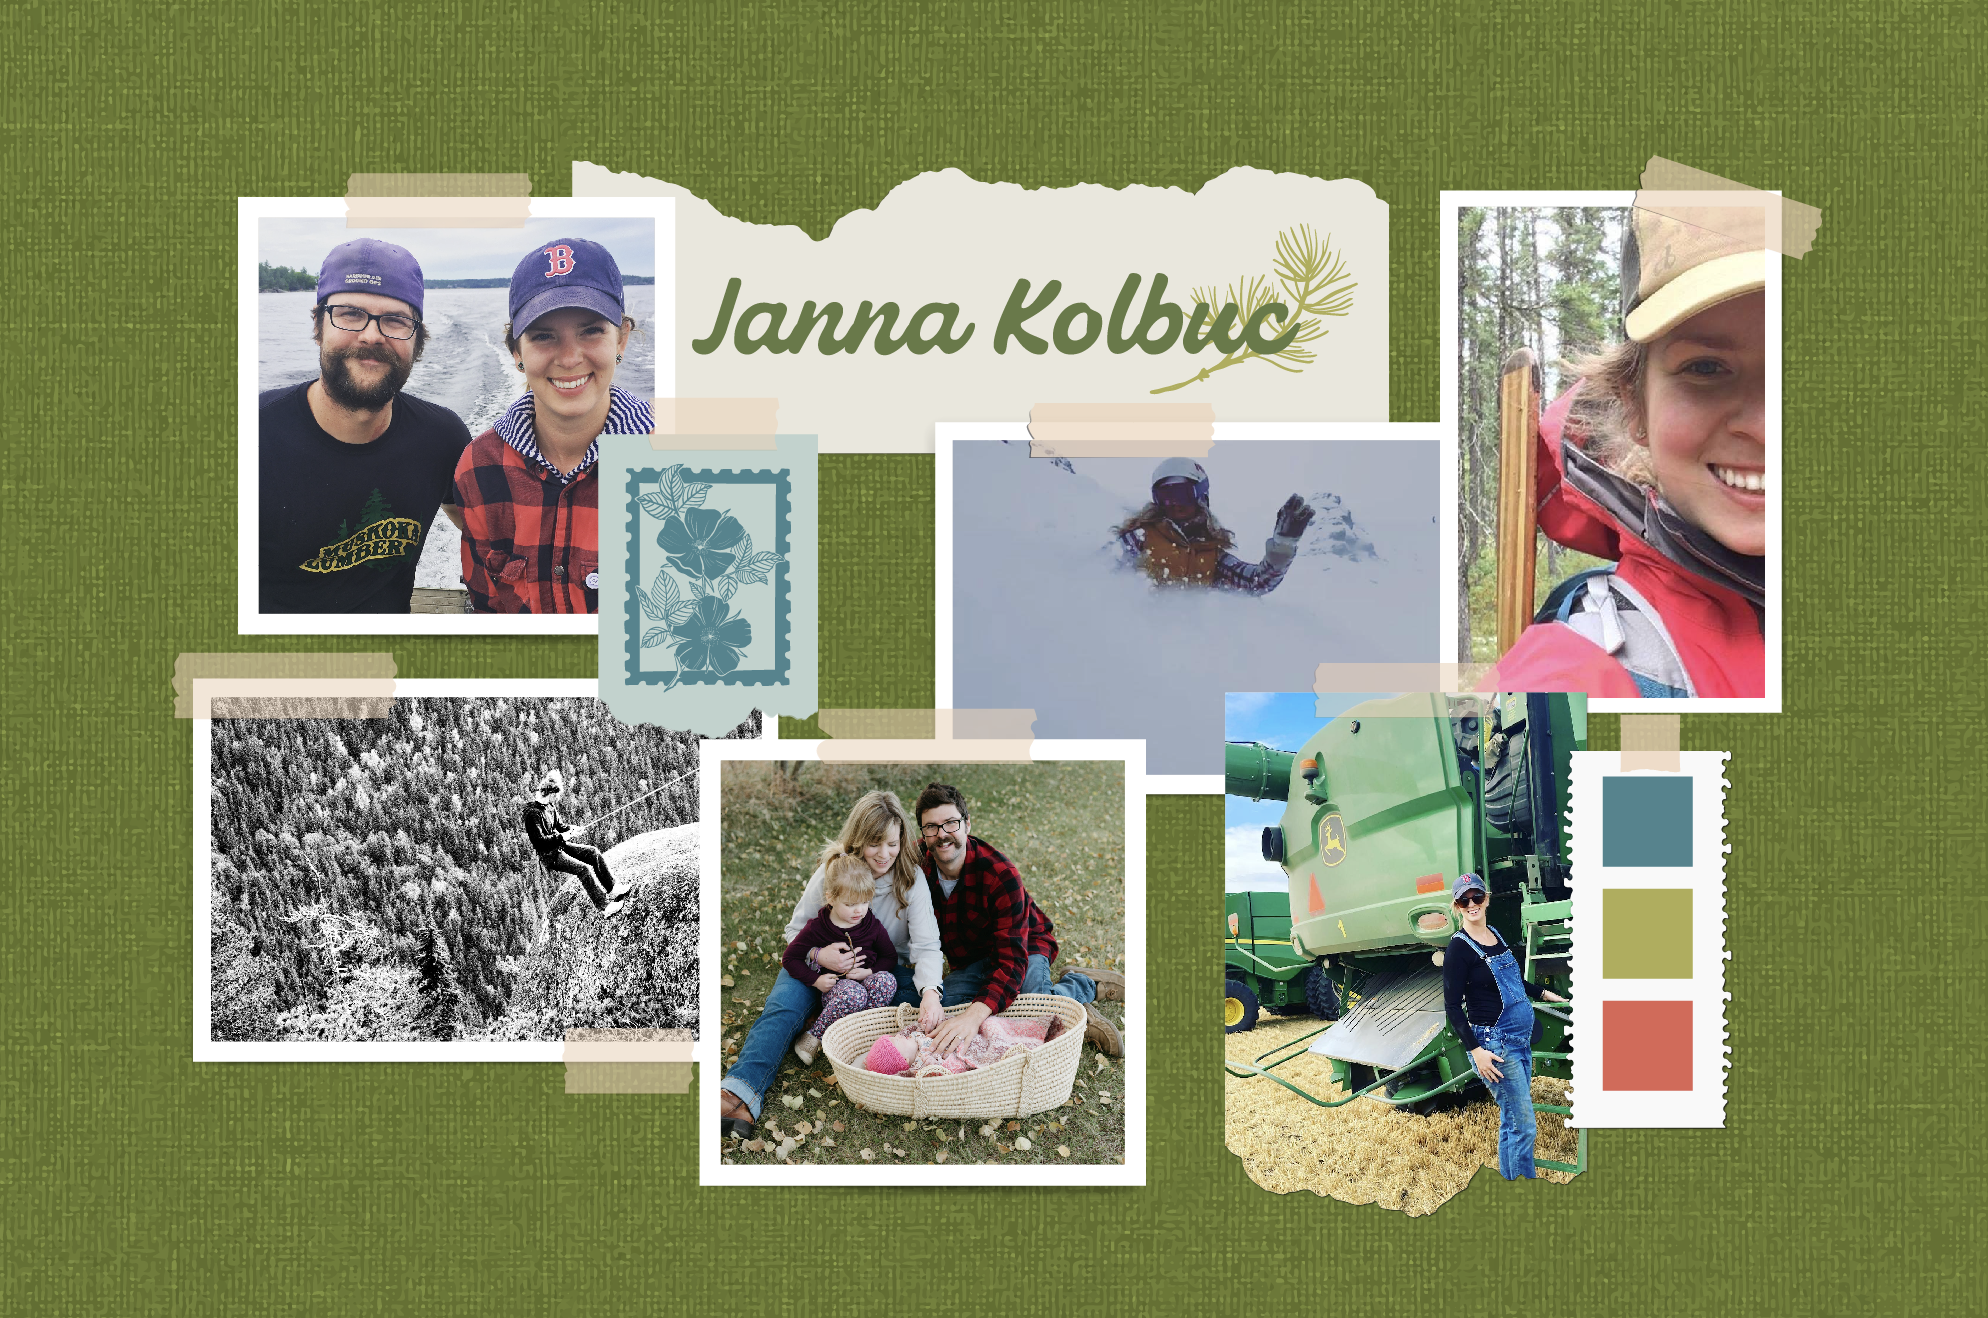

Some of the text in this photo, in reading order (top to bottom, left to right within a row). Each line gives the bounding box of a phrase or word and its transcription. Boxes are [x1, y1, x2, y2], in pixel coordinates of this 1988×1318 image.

[544, 244, 577, 278] B
[303, 540, 404, 572] LUMBER
[321, 519, 420, 559] MUSKOKA
